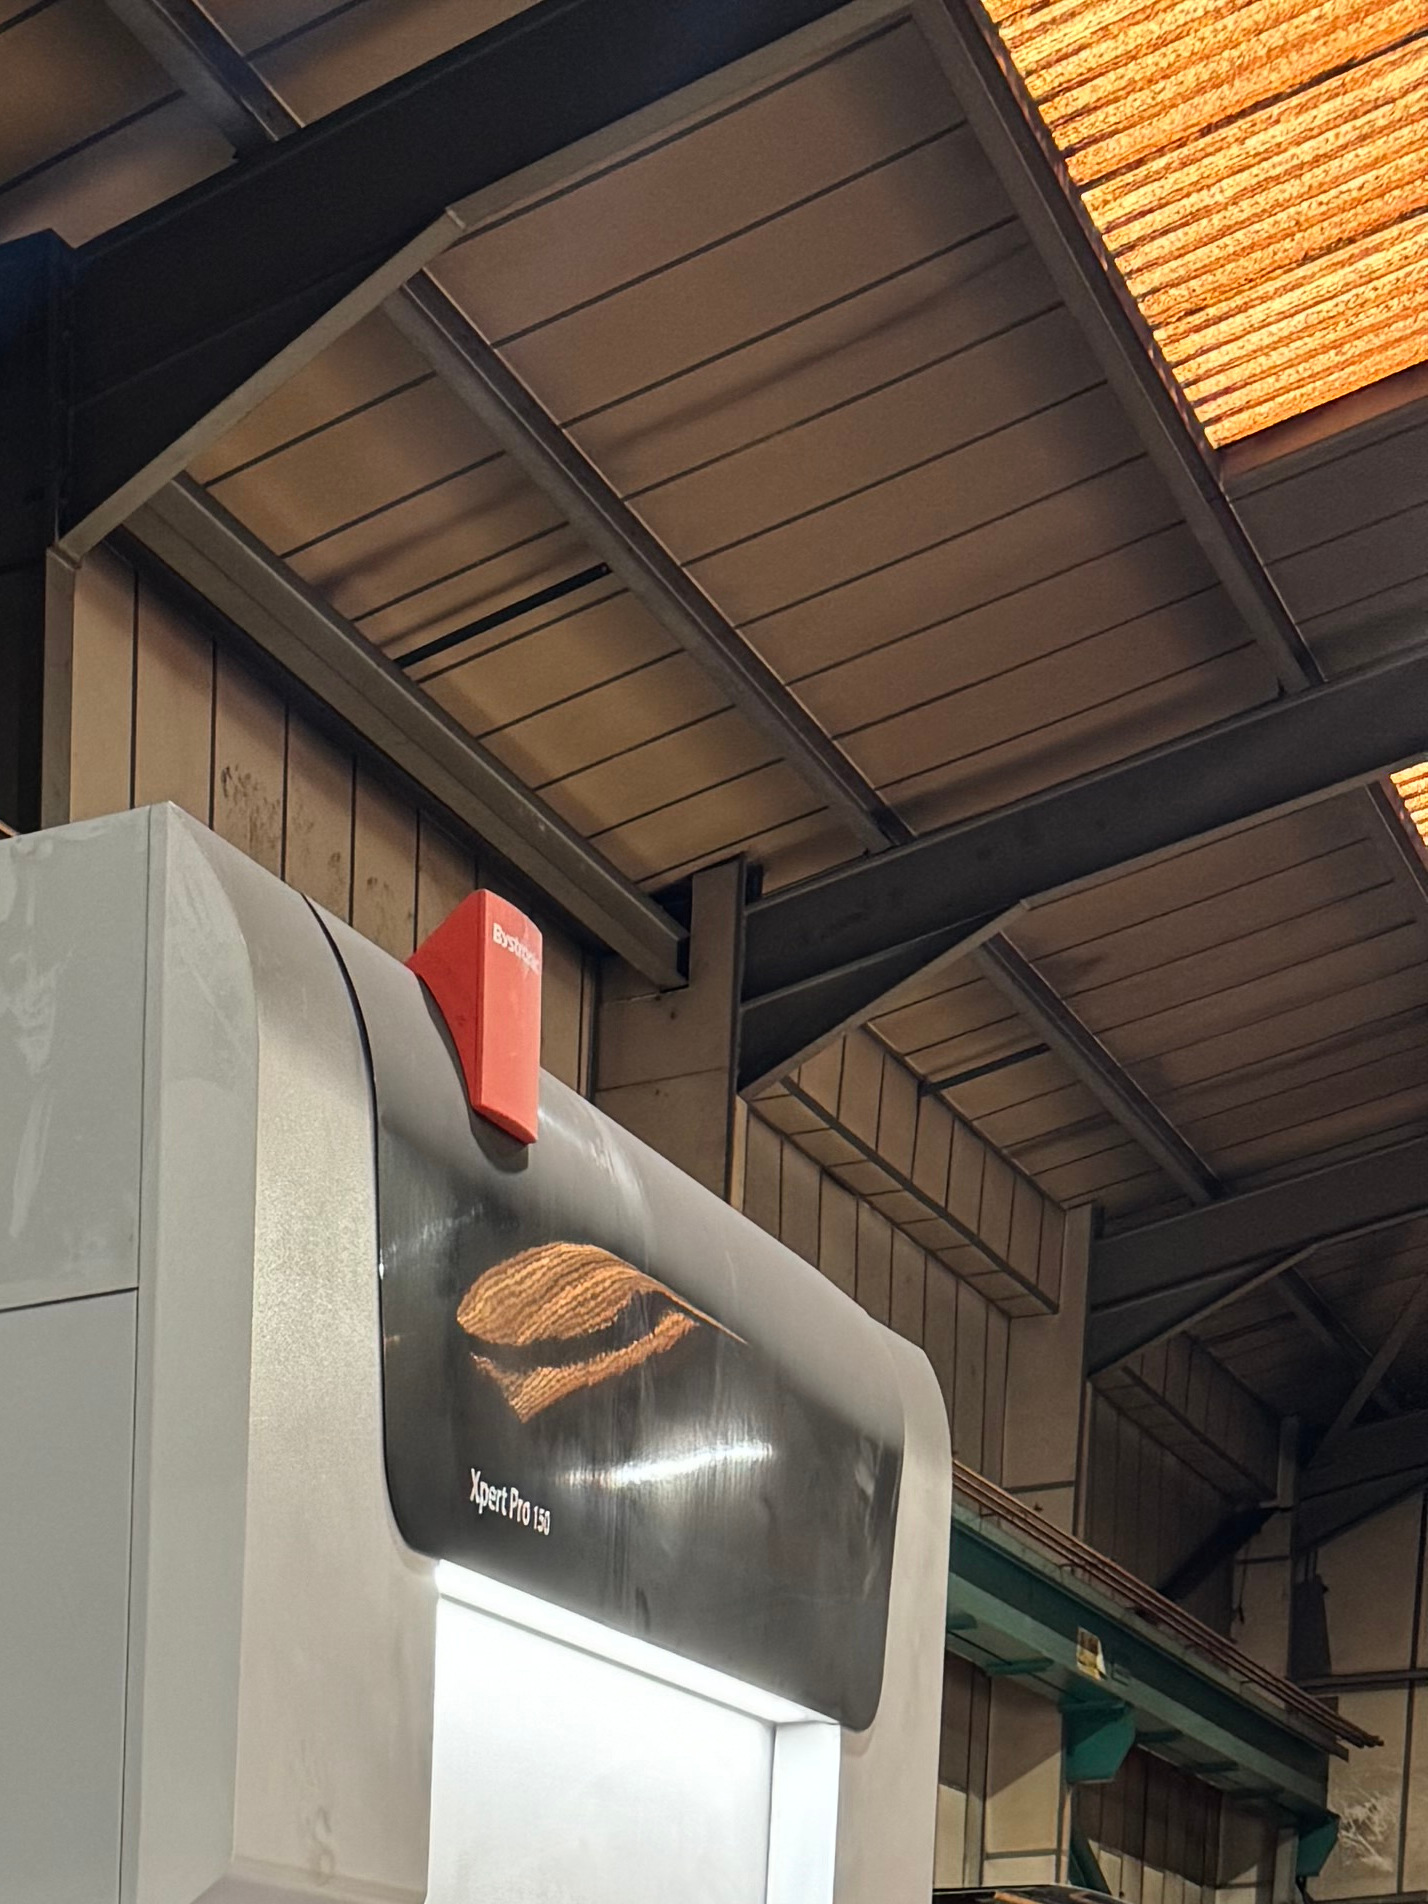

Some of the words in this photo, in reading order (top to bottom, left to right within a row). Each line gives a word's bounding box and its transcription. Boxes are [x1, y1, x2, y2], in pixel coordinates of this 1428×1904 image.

[470, 1467, 507, 1514] Xpert
[509, 1486, 530, 1526] Pro
[533, 1506, 551, 1536] 150
